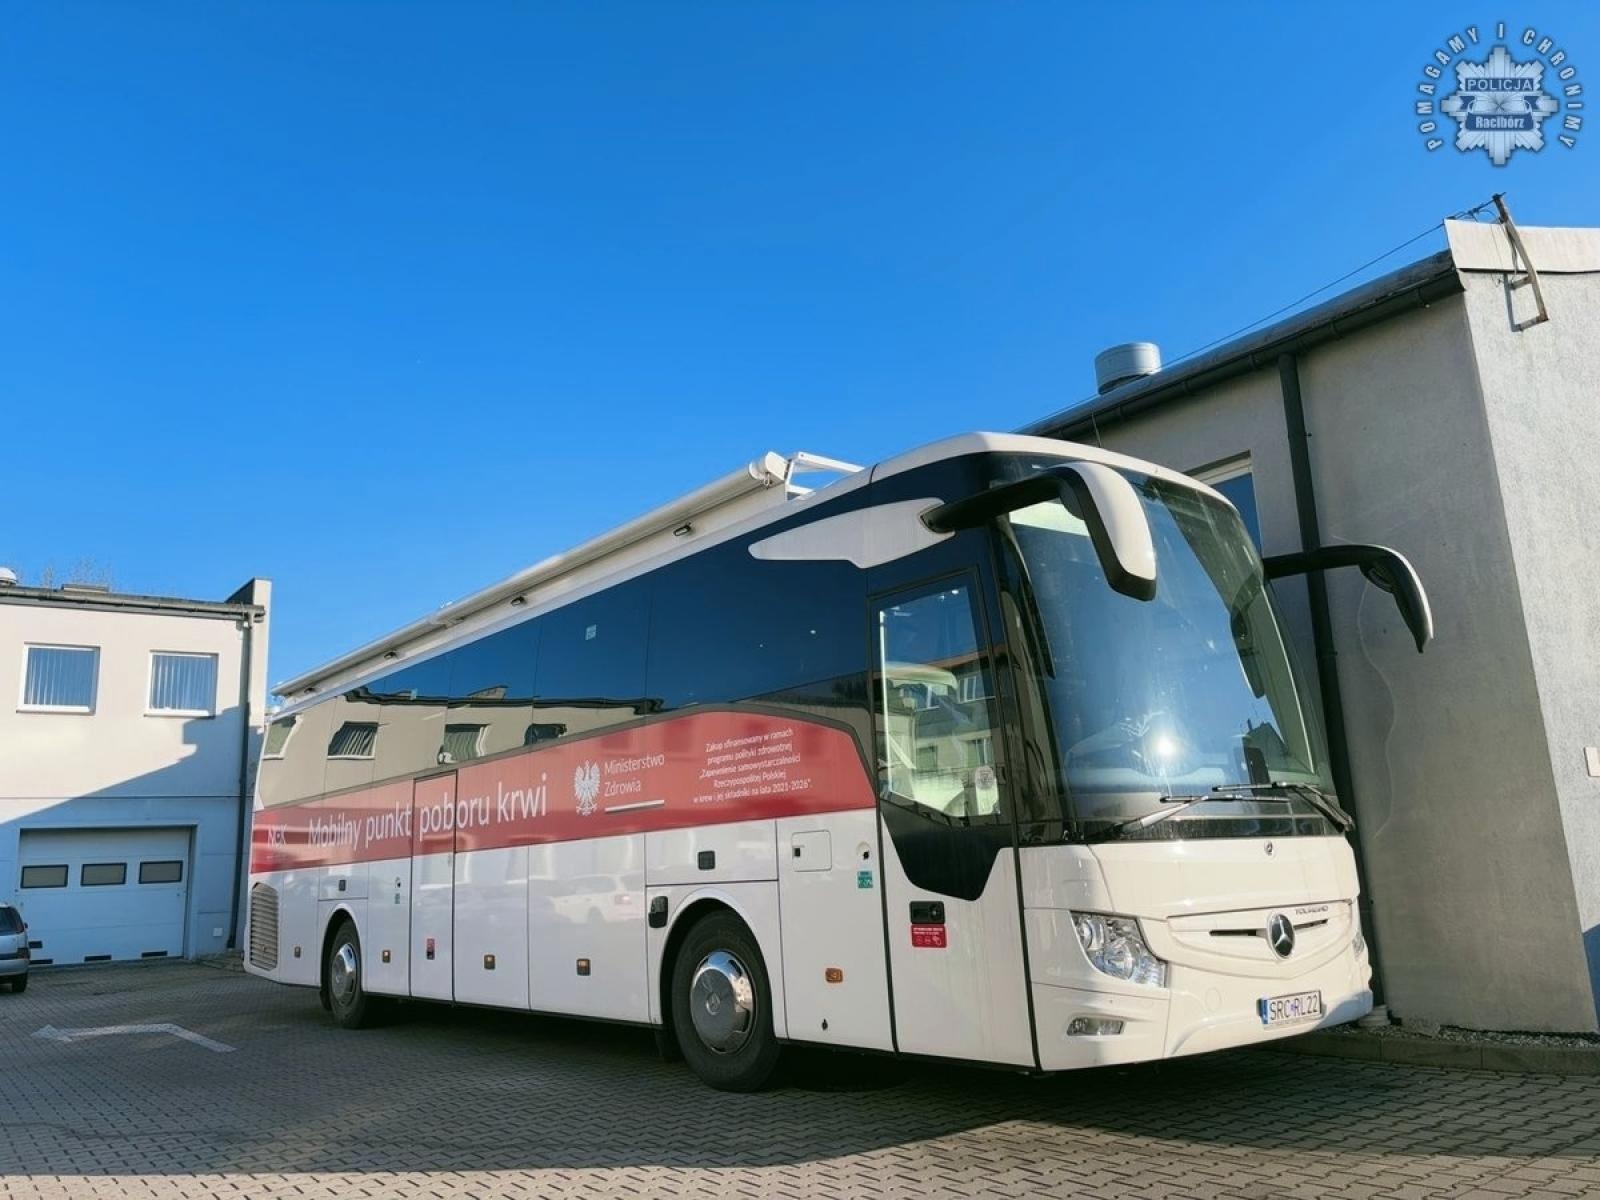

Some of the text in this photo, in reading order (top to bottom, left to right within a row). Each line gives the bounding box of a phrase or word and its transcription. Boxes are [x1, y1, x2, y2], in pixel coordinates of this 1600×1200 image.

[705, 742, 723, 753] Zakup
[604, 752, 665, 775] Ministerstwo
[762, 770, 786, 782] Polskiej
[604, 779, 642, 797] Zdrowia
[759, 785, 772, 795] lata
[307, 772, 548, 851] Mobilny punkt poboru krwi
[1269, 999, 1290, 1021] SRC
